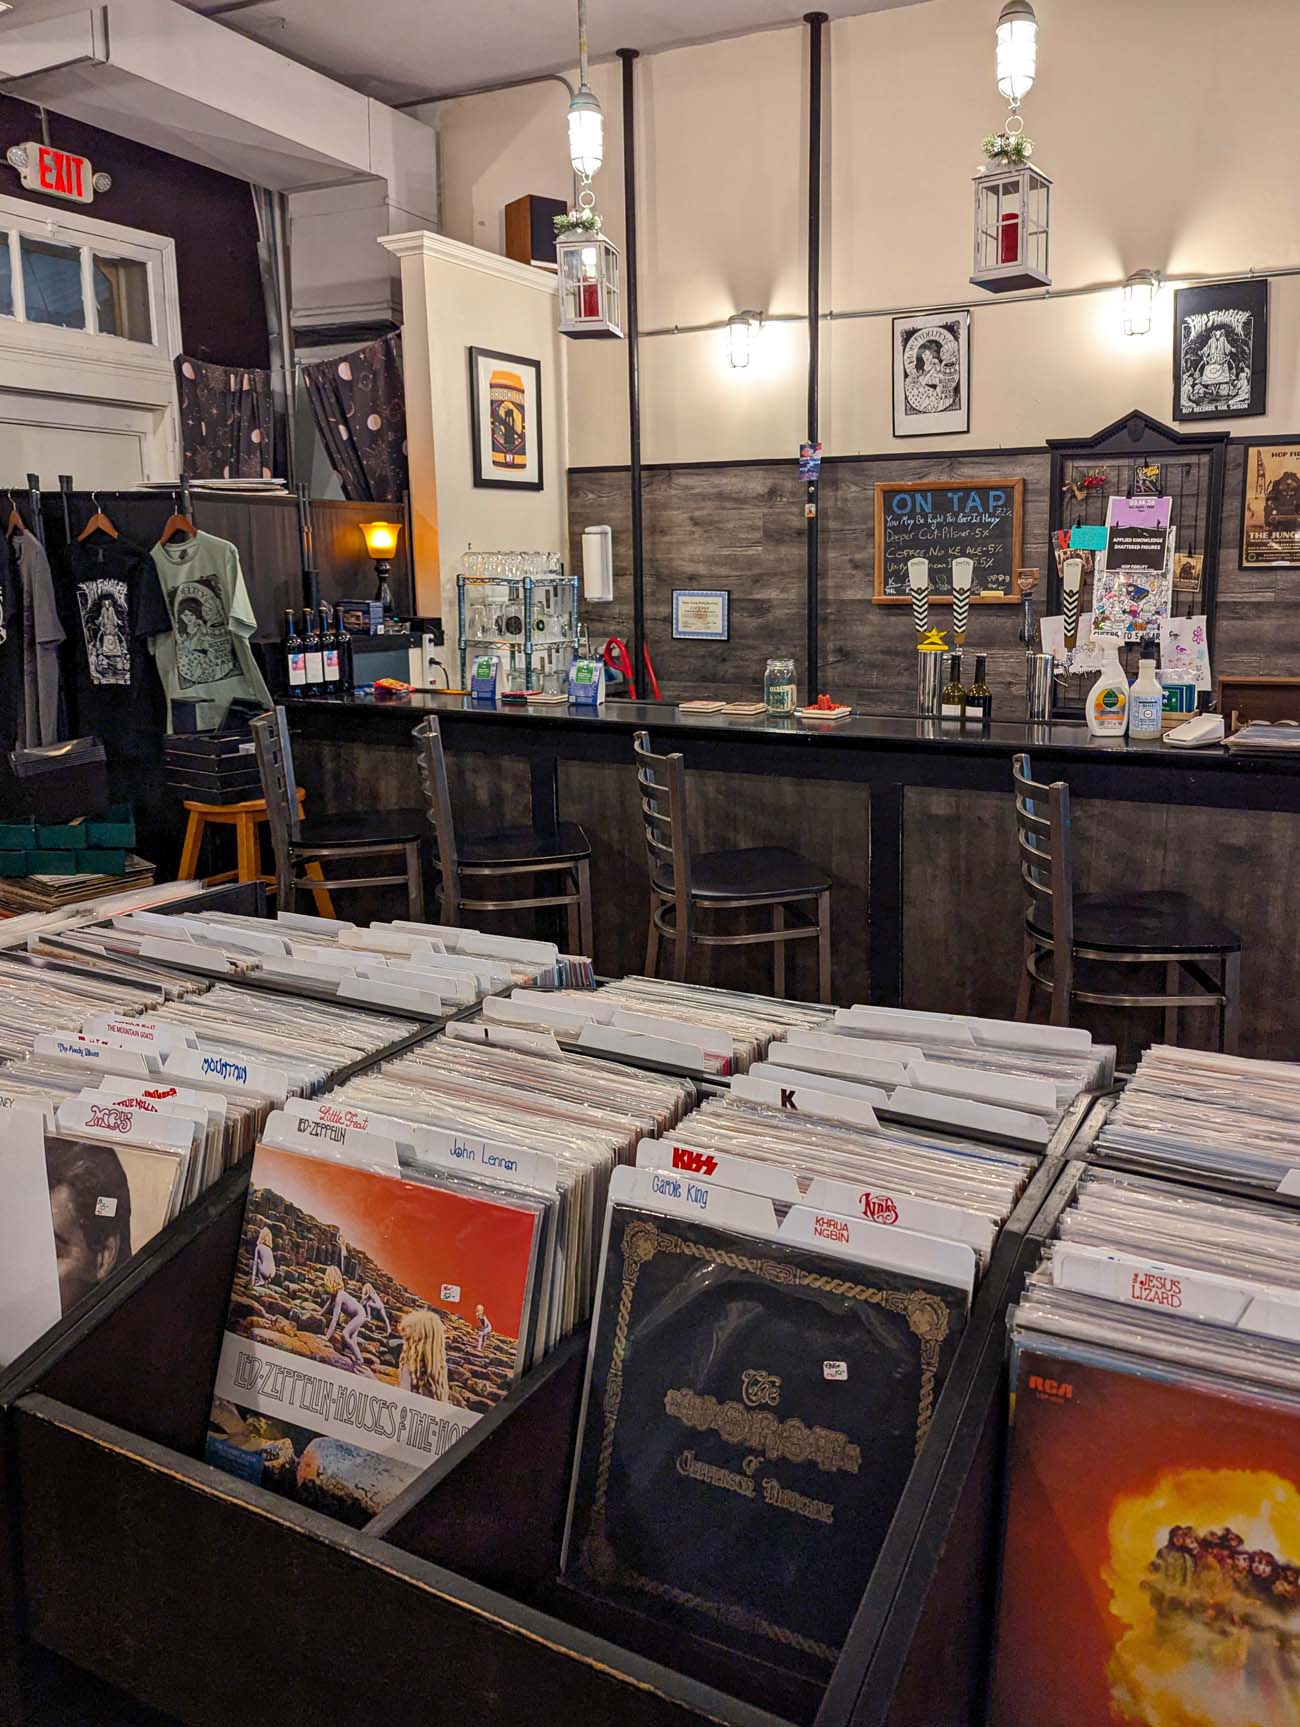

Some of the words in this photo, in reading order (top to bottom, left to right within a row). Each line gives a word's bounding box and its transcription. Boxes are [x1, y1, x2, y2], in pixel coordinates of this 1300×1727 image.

[38, 147, 84, 197] EXIT
[1182, 405, 1193, 414] BUY
[1229, 401, 1249, 410] SAISON
[891, 492, 933, 514] ON
[947, 490, 1006, 513] TAP
[886, 514, 899, 527] You
[900, 515, 914, 531] May
[916, 514, 925, 525] Be
[957, 513, 972, 524] Beer
[971, 513, 981, 523] Is
[107, 1023, 116, 1033] THE
[116, 1025, 140, 1037] MOUNTAIN
[140, 1031, 154, 1041] GOATS
[201, 1057, 249, 1084] MOUNTAIN
[780, 1088, 799, 1111] K
[84, 1104, 133, 1133] MC5
[319, 1104, 345, 1125] Little
[344, 1110, 369, 1131] Feat
[449, 1137, 476, 1161] John
[481, 1143, 518, 1173] Lennon
[672, 1147, 719, 1177] KISS
[651, 1175, 682, 1199] Carole
[686, 1183, 709, 1209] King
[814, 1226, 849, 1244] NGBIN
[815, 1215, 849, 1233] KHRUA
[1131, 1284, 1182, 1308] LIZARD
[1139, 1273, 1182, 1295] JESUS
[1028, 1375, 1073, 1398] RCA
